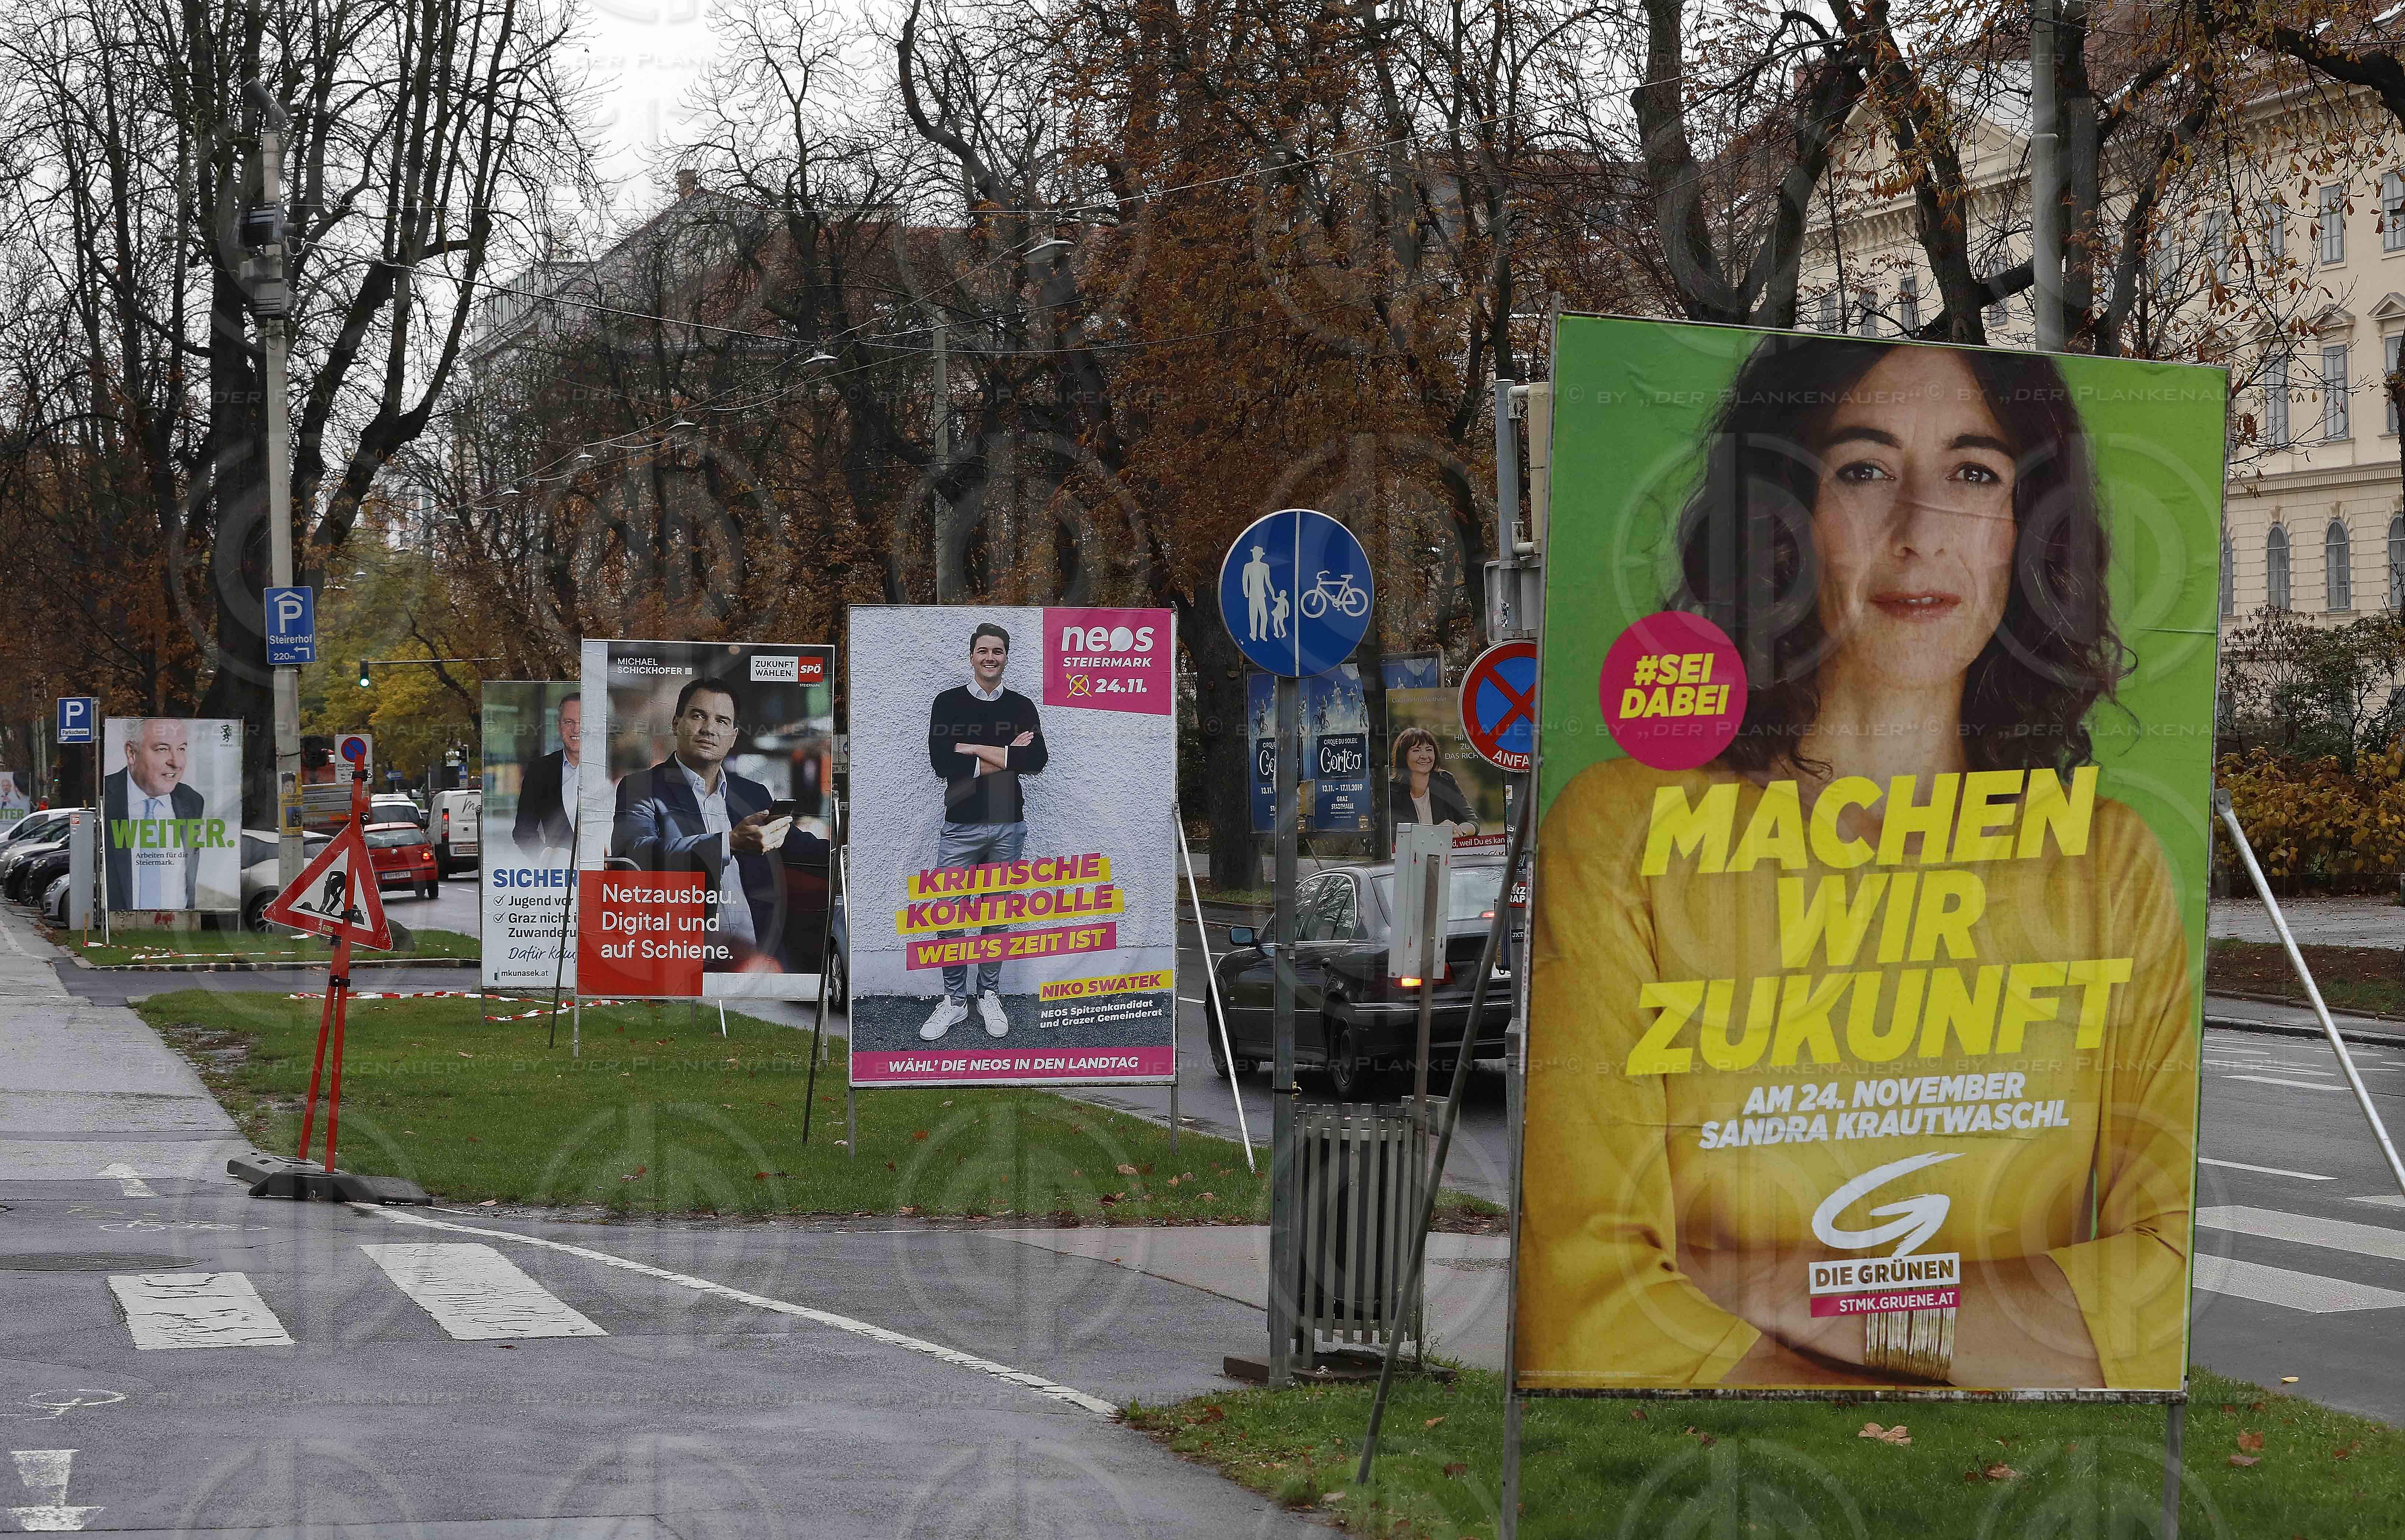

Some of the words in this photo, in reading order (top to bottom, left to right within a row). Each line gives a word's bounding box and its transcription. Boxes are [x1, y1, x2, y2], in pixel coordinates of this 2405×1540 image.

[279, 601, 302, 634] P
[269, 634, 312, 644] Steirerhof
[1061, 626, 1154, 652] neos
[617, 658, 658, 666] MICHAEL
[617, 666, 682, 675] SCHICKHOFER
[755, 660, 795, 669] ZUKUNFT
[755, 667, 794, 677] WÄHLEN.
[800, 664, 821, 674] SPÖ
[1063, 657, 1152, 668] STEIERMARK
[1634, 653, 1714, 686] #SEI
[1095, 678, 1148, 693] 24.11.
[1619, 685, 1730, 719] DABEI
[66, 701, 84, 727] P
[1320, 747, 1362, 773] Corteo
[1340, 784, 1362, 792] 17.11.2019
[1641, 766, 2098, 876] MACHEN
[111, 819, 236, 849] WEITER.
[917, 853, 1101, 895] KRITISCHE
[508, 895, 551, 908] Jugend
[602, 883, 737, 904] Netzausbau.
[508, 913, 537, 923] Graz
[540, 912, 570, 923] nicht
[906, 884, 1114, 929] KONTROLLE
[602, 911, 670, 935] Digital
[678, 913, 720, 932] und
[1777, 869, 1986, 968] WIR
[508, 946, 546, 962] Dafür
[601, 939, 635, 959] auf
[641, 939, 734, 959] Schiene.
[917, 939, 1002, 965] WEIL’S
[1008, 932, 1062, 956] ZEIT
[1069, 928, 1106, 949] IST
[1042, 983, 1084, 998] NIKO
[1087, 973, 1161, 993] SWATEK
[1040, 1019, 1060, 1028] und
[1062, 1015, 1095, 1026] Grazer
[1097, 1009, 1162, 1023] Gemeinderat
[1041, 1008, 1068, 1018] NEOS
[1070, 999, 1153, 1017] Spitzenkandidat
[1625, 958, 2133, 1075] ZUKUNFT
[941, 1059, 967, 1071] DIE
[969, 1058, 1011, 1071] NEOS
[1014, 1057, 1032, 1070] IN
[1034, 1057, 1066, 1070] DEN
[1068, 1055, 1139, 1068] LANDTAG
[1743, 1085, 1793, 1114] AM
[1799, 1082, 1845, 1111] 24.
[1852, 1072, 2026, 1107] NOVEMBER
[1698, 1116, 1828, 1149] SANDRA
[1834, 1100, 2070, 1140] KRAUTWASCHL
[1815, 1267, 1853, 1288] DIE
[1858, 1259, 1955, 1284] GRÜNEN
[1839, 1292, 1955, 1313] STMK.GRUENE.AT
